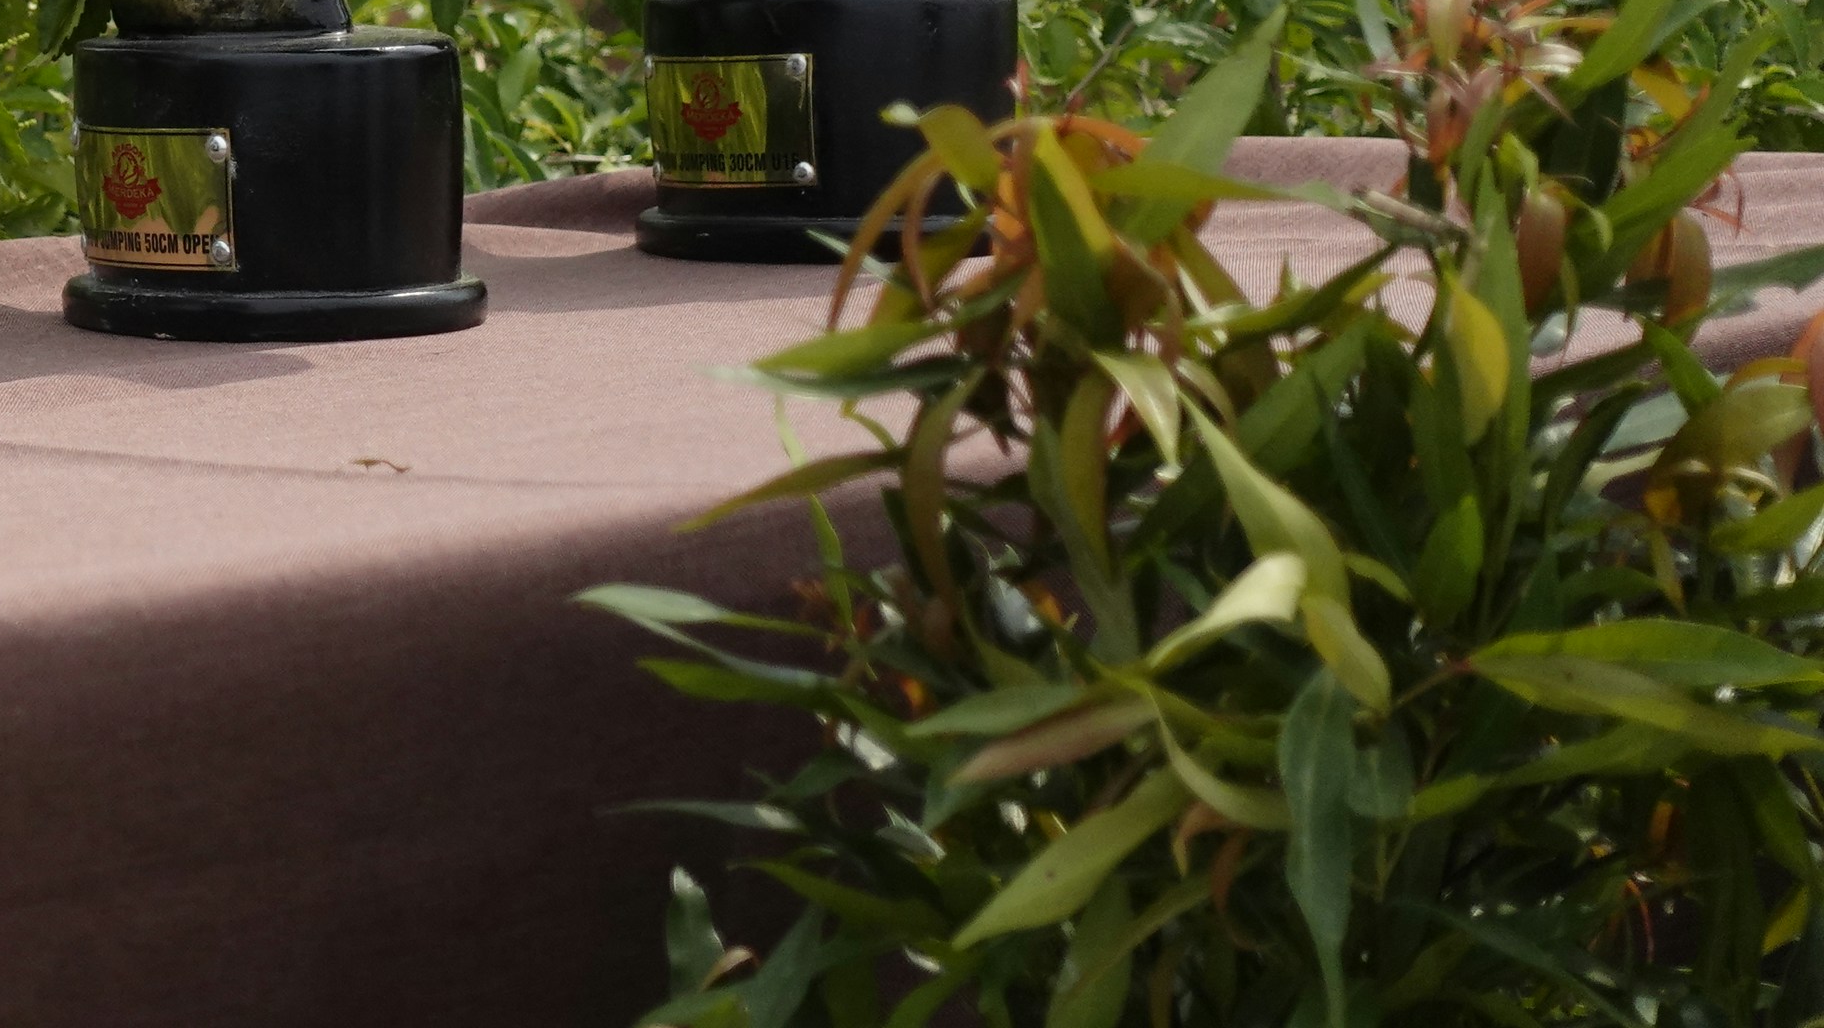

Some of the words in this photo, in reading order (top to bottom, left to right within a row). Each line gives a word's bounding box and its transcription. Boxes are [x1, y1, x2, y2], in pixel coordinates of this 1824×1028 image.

[729, 153, 766, 172] 30CM
[107, 184, 155, 199] MERDEKA
[100, 230, 141, 253] JUMPING
[144, 232, 179, 254] 50CM
